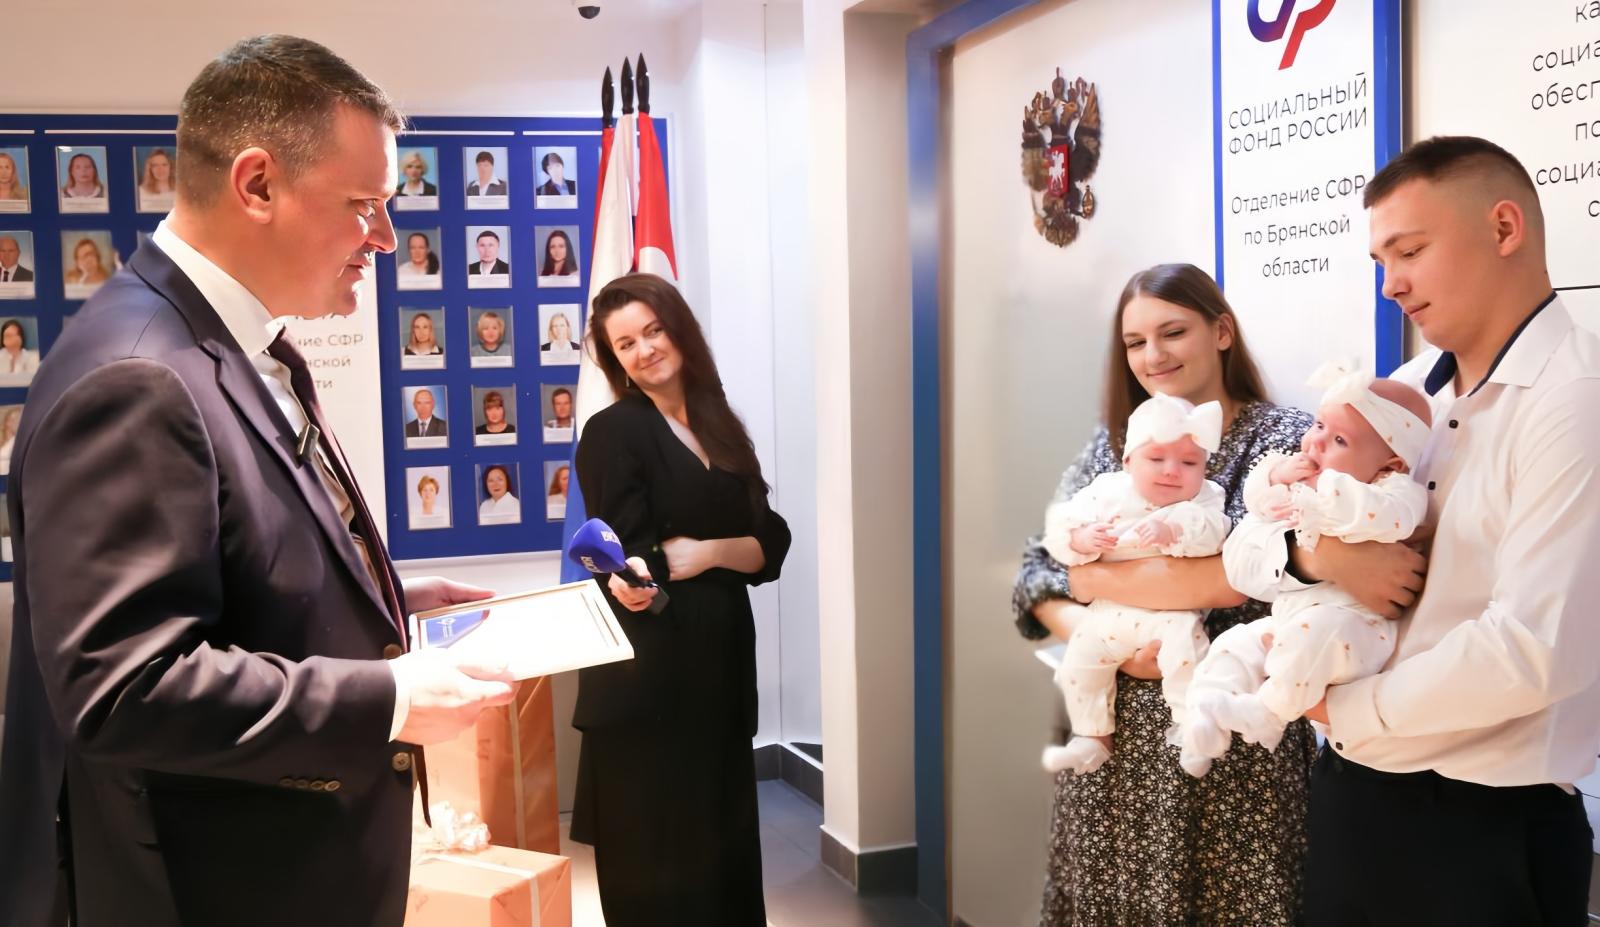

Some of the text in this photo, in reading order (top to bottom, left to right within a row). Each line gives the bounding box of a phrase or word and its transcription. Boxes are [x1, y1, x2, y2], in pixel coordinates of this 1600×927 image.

[1228, 72, 1368, 130] СОЦИАЛЬНЫЙ
[1229, 107, 1368, 155] ФОНД РОССИИ
[1231, 174, 1367, 215] Отделение СФР
[1244, 213, 1351, 247] по Брянской
[1262, 255, 1330, 278] области
[327, 334, 364, 347] СФР
